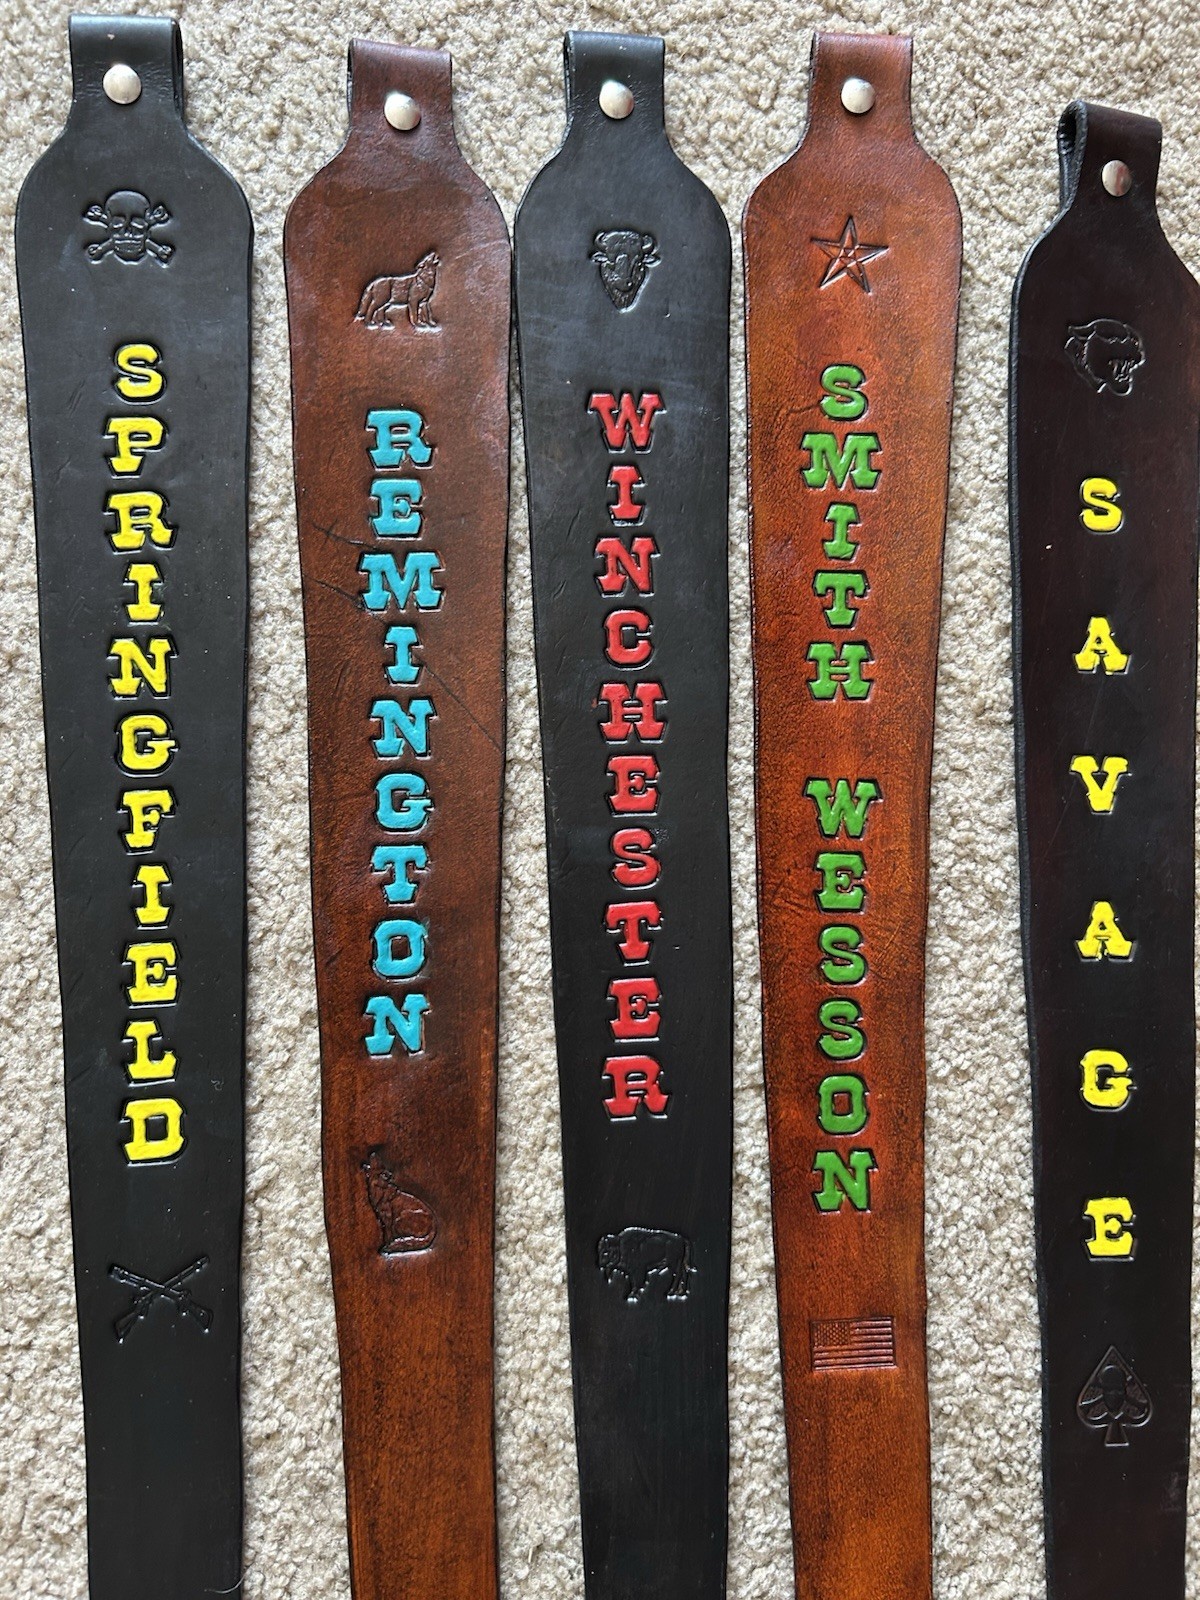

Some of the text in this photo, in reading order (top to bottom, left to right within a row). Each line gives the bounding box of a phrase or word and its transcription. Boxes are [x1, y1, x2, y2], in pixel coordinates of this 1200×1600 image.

[107, 345, 184, 1163] SPRINGFIELD
[360, 409, 442, 1055] REMINGTON
[588, 393, 669, 1117] WINCHESTER
[801, 364, 880, 1211] SMITH WESSON
[1070, 476, 1134, 1258] SAVAGE
